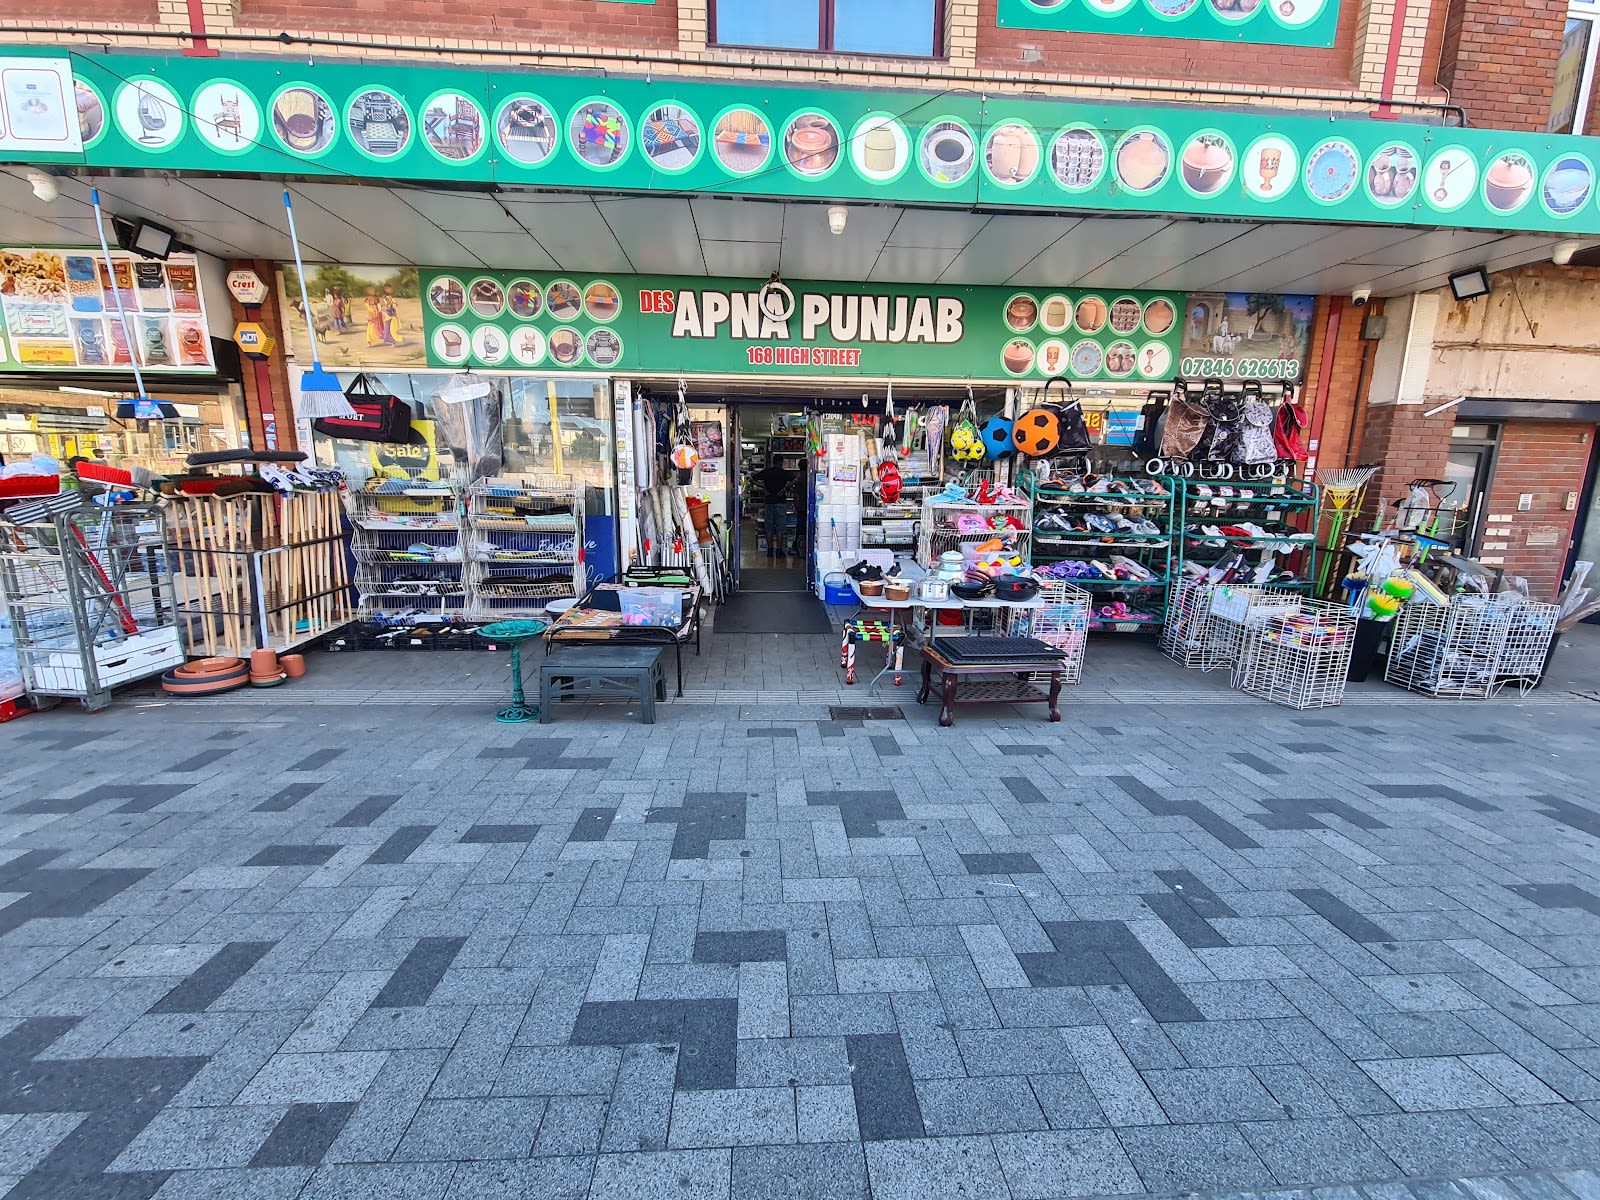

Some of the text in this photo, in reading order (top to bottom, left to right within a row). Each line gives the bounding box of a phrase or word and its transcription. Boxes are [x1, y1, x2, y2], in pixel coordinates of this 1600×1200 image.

[232, 280, 255, 289] Crest
[640, 290, 676, 314] DES
[672, 290, 964, 343] APNA PUNJAB
[241, 332, 257, 342] ADT
[747, 346, 862, 367] 168 HIGH STREET
[1181, 357, 1300, 379] 07846 626613
